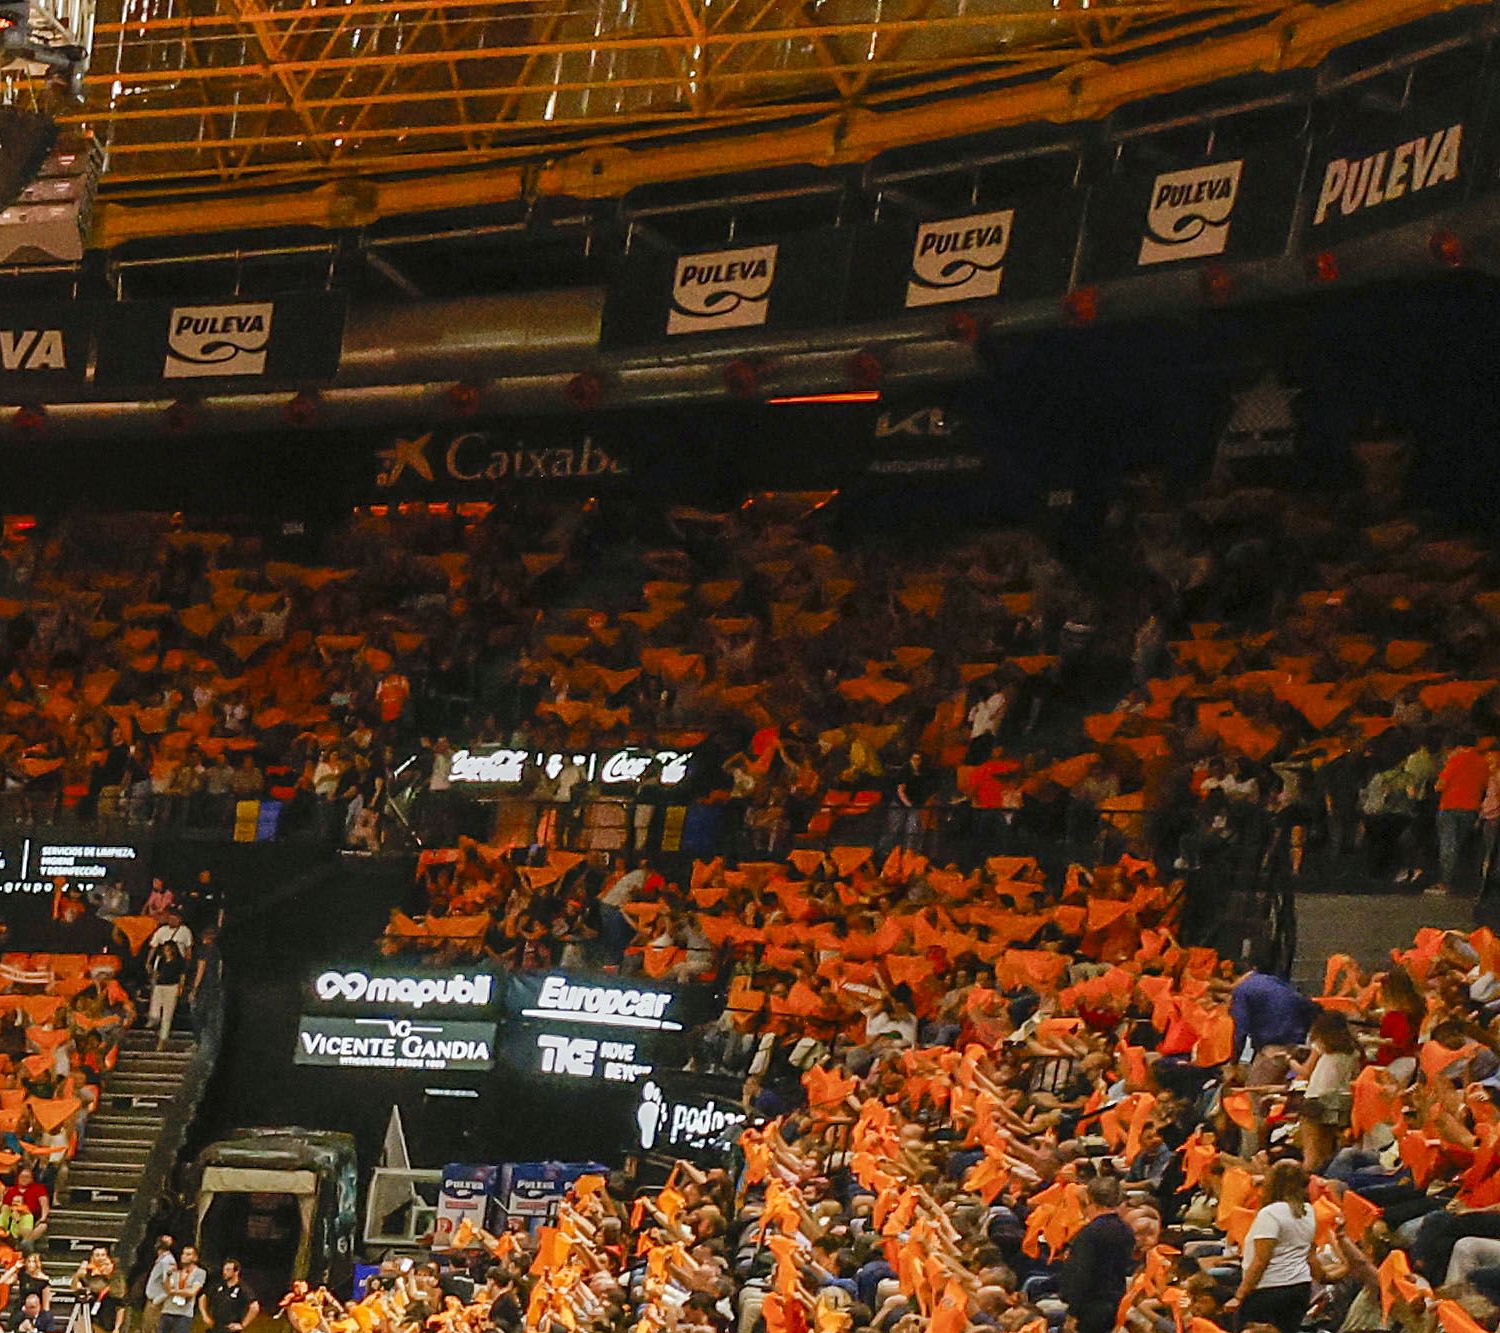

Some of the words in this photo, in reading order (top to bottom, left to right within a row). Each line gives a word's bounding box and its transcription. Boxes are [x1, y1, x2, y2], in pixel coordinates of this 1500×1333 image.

[1314, 124, 1462, 224] PULEVA
[1156, 177, 1233, 209] PULEVA
[920, 225, 1004, 258] PULEVA
[681, 260, 767, 289] PULEVA
[175, 315, 265, 337] PULEVA
[538, 976, 671, 1017] Europcar
[302, 1032, 396, 1056] VICENTE
[402, 1036, 488, 1060] GANDIA
[538, 1035, 597, 1076] TKE
